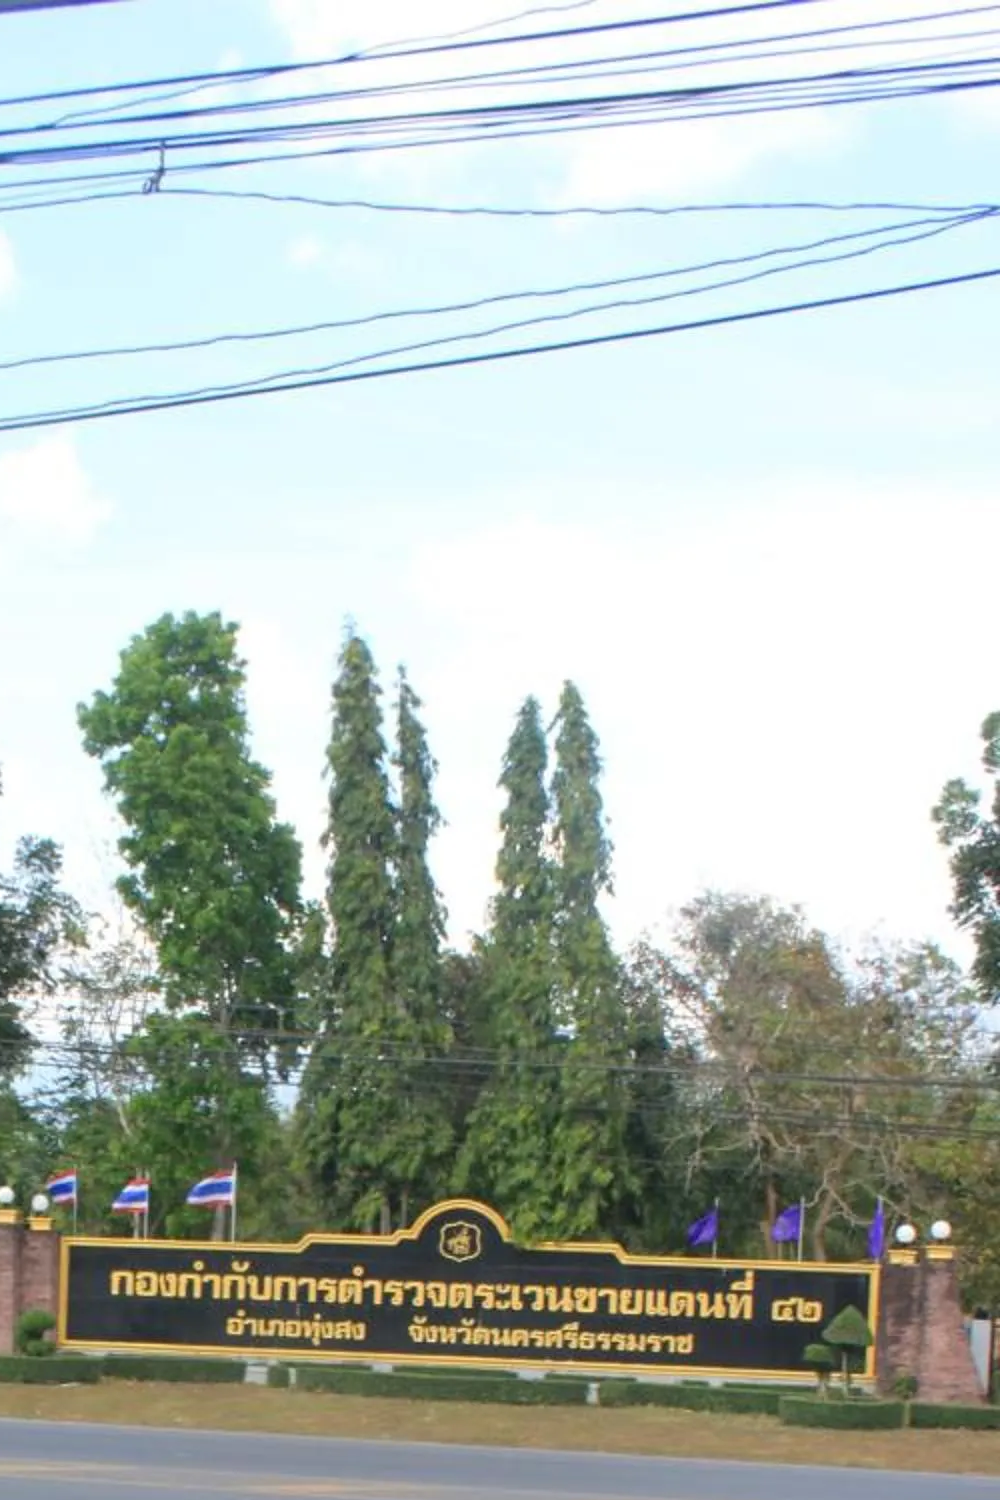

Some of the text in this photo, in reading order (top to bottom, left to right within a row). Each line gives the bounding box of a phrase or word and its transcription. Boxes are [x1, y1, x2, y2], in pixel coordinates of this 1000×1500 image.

[110, 1260, 823, 1323] กองกำกับการตำรวจตระเวนชายแดนที่ ๔๒
[225, 1309, 695, 1354] อำเภอทุ่งสง จังหวัดนครศรีธรรมราช
